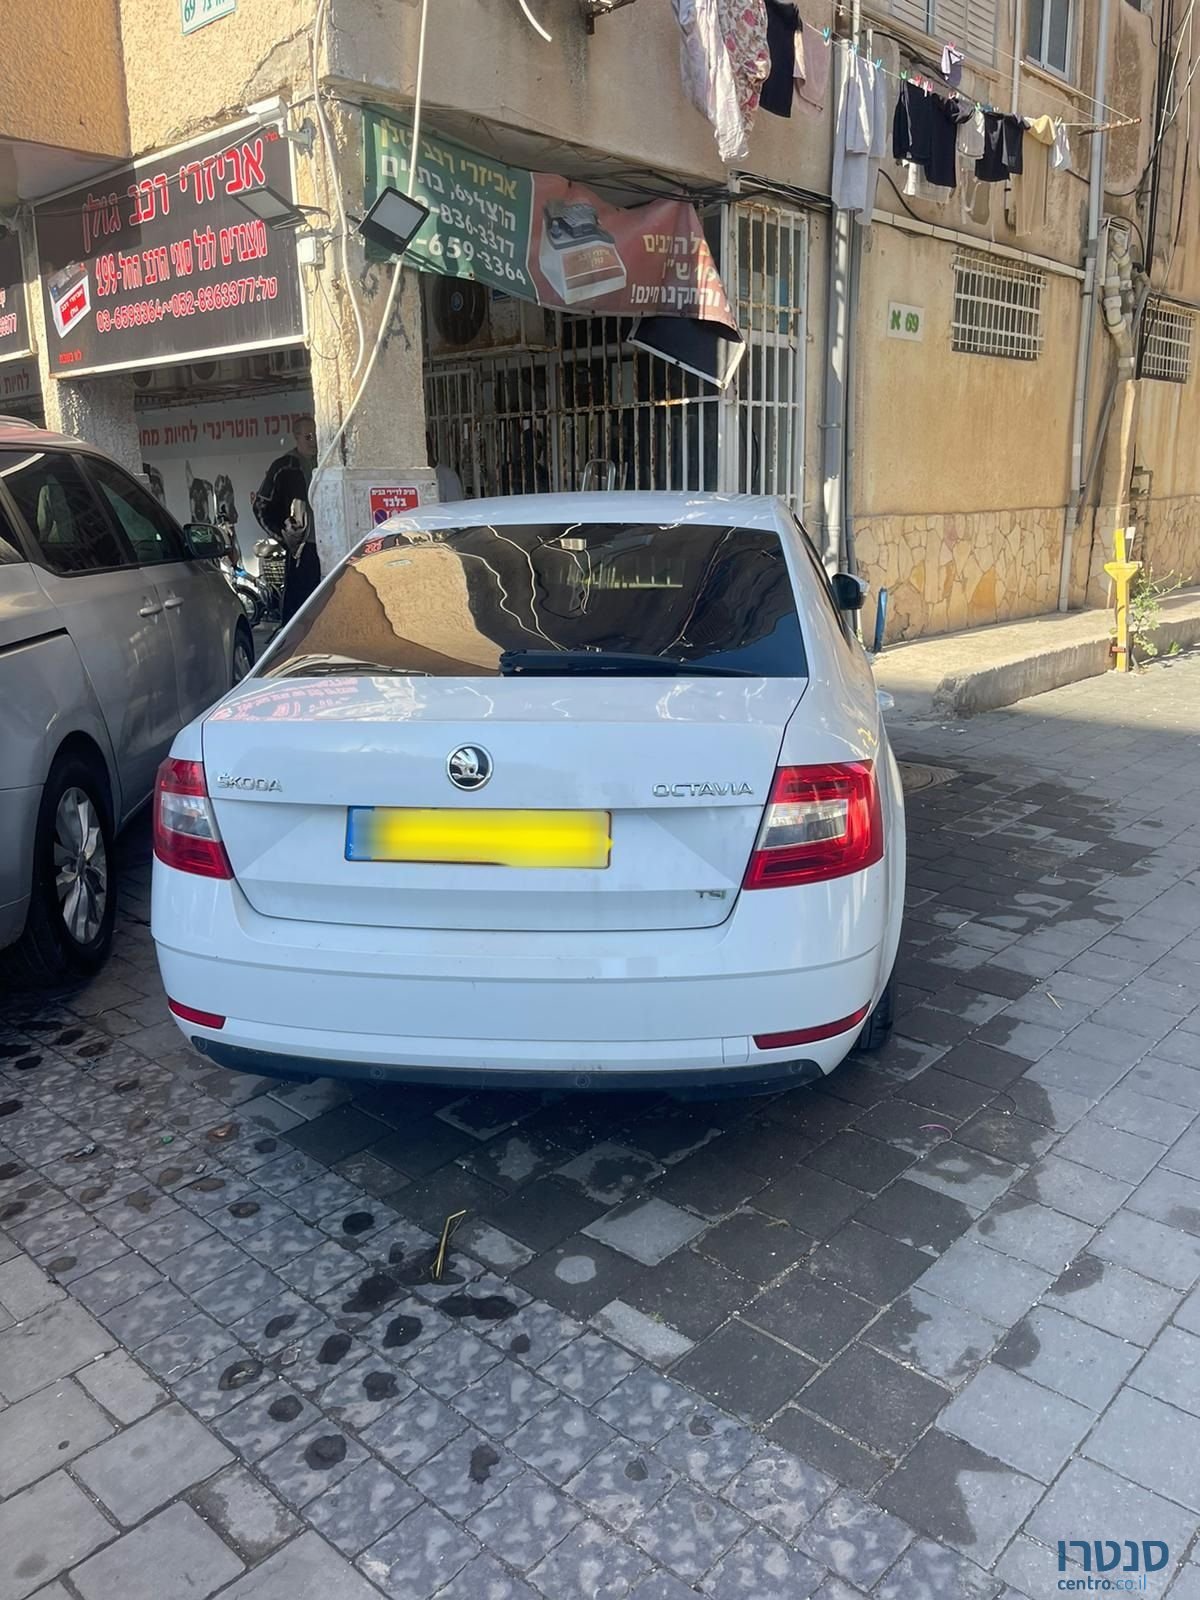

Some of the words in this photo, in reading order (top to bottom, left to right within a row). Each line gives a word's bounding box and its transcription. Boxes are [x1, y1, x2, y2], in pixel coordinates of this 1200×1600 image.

[179, 138, 266, 204] אביזרי
[460, 159, 518, 200] אביזרי
[127, 172, 170, 226] רכב
[81, 192, 122, 253] גולן
[142, 245, 171, 285] הרכב
[170, 238, 194, 278] סוגי
[193, 225, 217, 271] לכל
[164, 418, 199, 445] לחיות
[202, 416, 259, 440] הוטרינרי
[383, 496, 407, 507] בלבד
[653, 782, 754, 797] OCTAVIA
